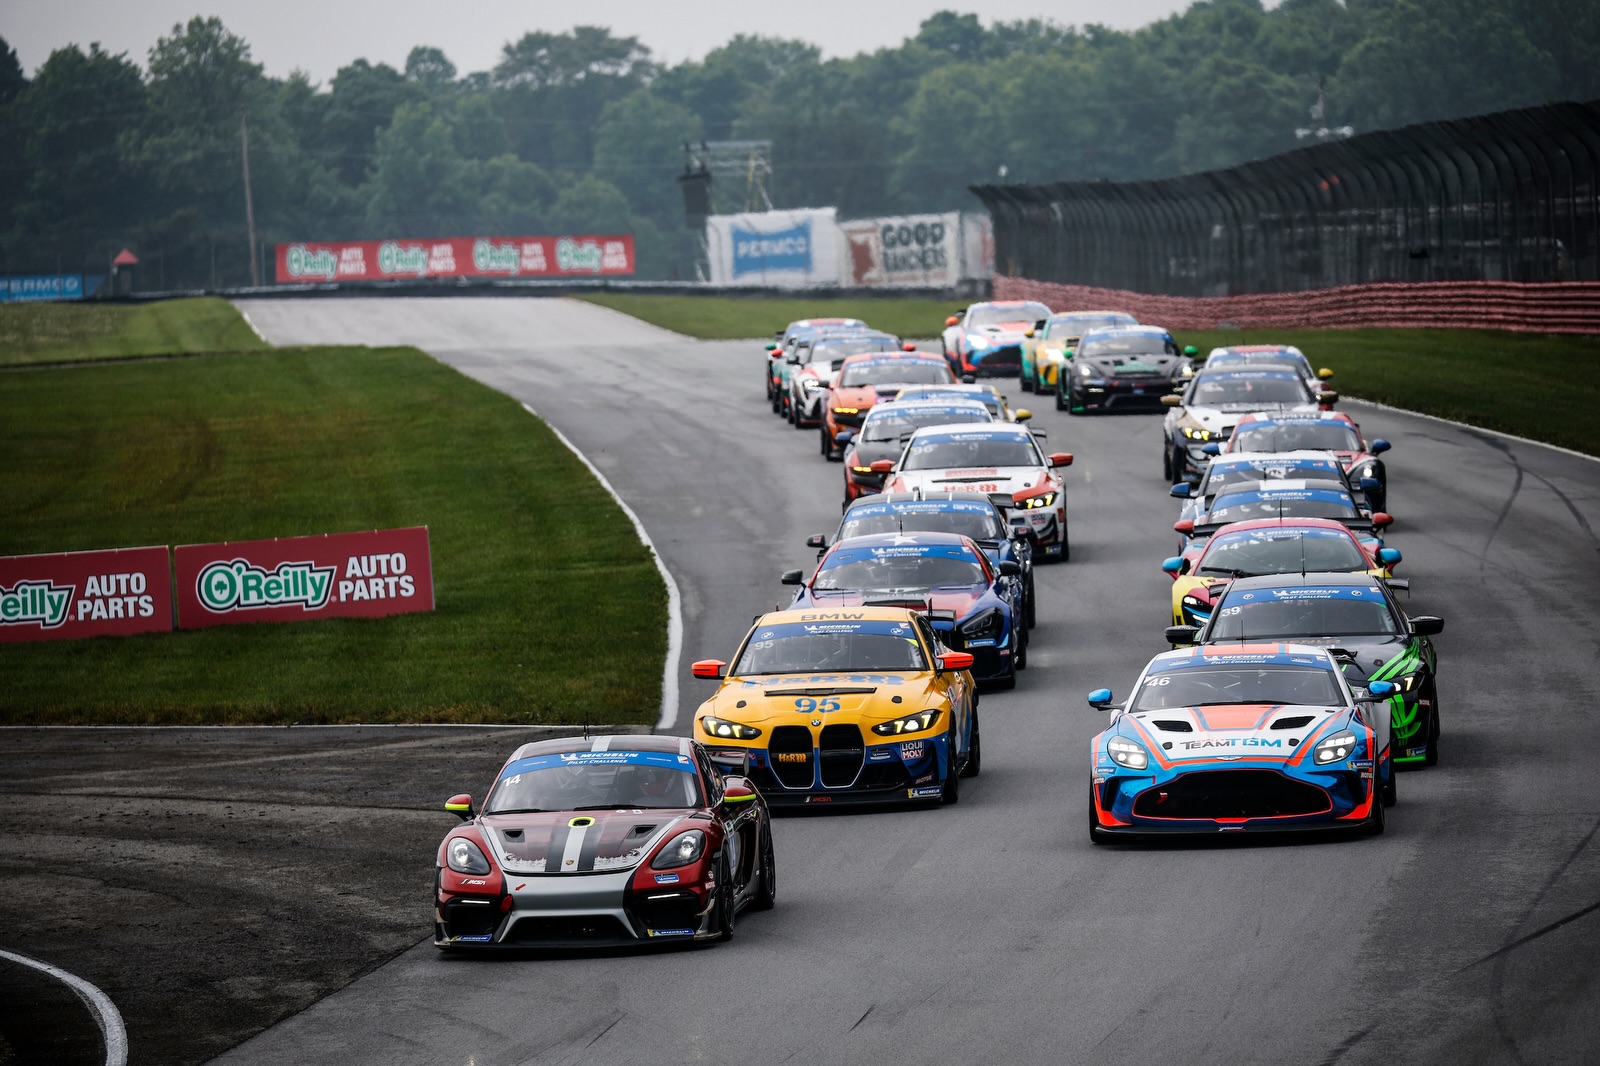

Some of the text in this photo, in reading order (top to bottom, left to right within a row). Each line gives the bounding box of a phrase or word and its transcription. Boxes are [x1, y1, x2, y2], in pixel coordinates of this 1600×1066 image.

[1209, 474, 1225, 483] 53
[1212, 509, 1228, 519] 28
[345, 552, 407, 578] AUTO
[84, 572, 147, 597] AUTO
[203, 564, 327, 606] O'Reilly
[338, 575, 415, 603] PARTS
[0, 587, 65, 621] eilly
[77, 595, 154, 621] PARTS
[800, 613, 865, 621] BMW
[1221, 607, 1241, 617] 39
[754, 641, 774, 650] 95
[1146, 677, 1171, 687] 46
[795, 697, 841, 714] 95
[901, 742, 923, 751] LIQUI
[778, 753, 796, 762] H&R
[902, 749, 924, 760] MOLY
[502, 774, 522, 787] 14
[918, 788, 940, 796] MICHELIN
